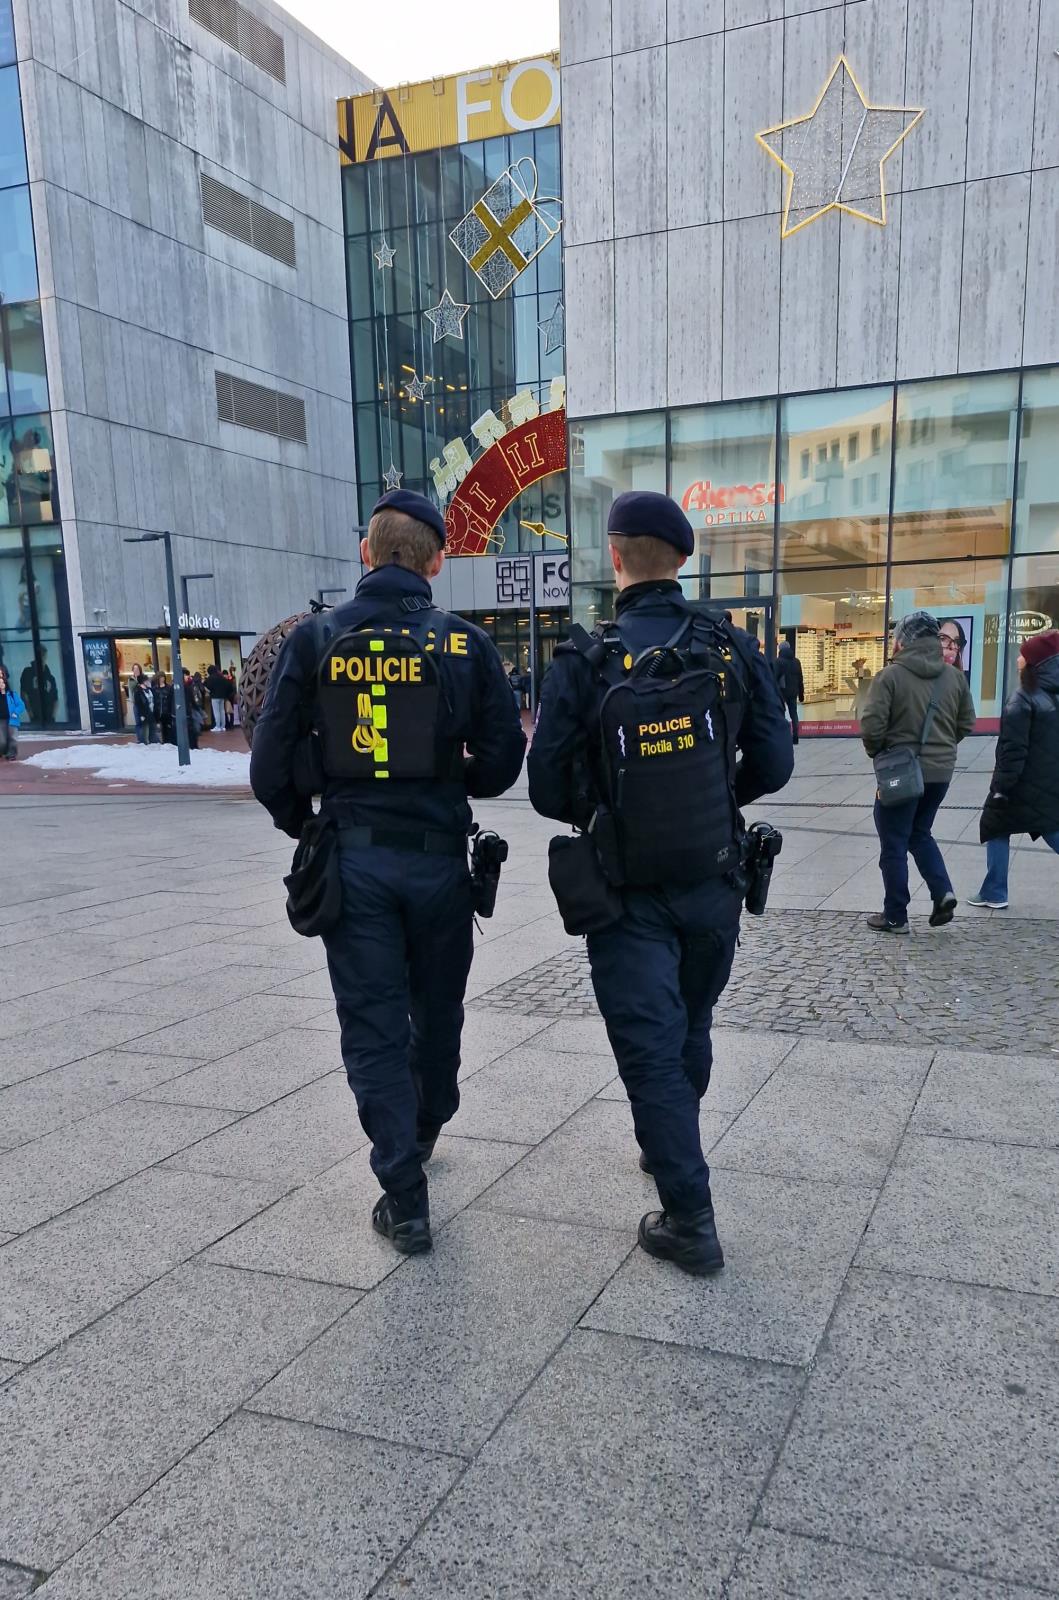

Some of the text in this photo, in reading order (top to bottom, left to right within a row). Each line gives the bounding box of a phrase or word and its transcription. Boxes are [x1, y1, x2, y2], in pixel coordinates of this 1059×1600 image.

[456, 58, 561, 144] FO
[704, 510, 767, 526] OPTIKA
[543, 586, 570, 599] NOV
[330, 656, 422, 682] POLICIE
[639, 716, 692, 736] POLICIE
[640, 734, 694, 757] Flotila 310
